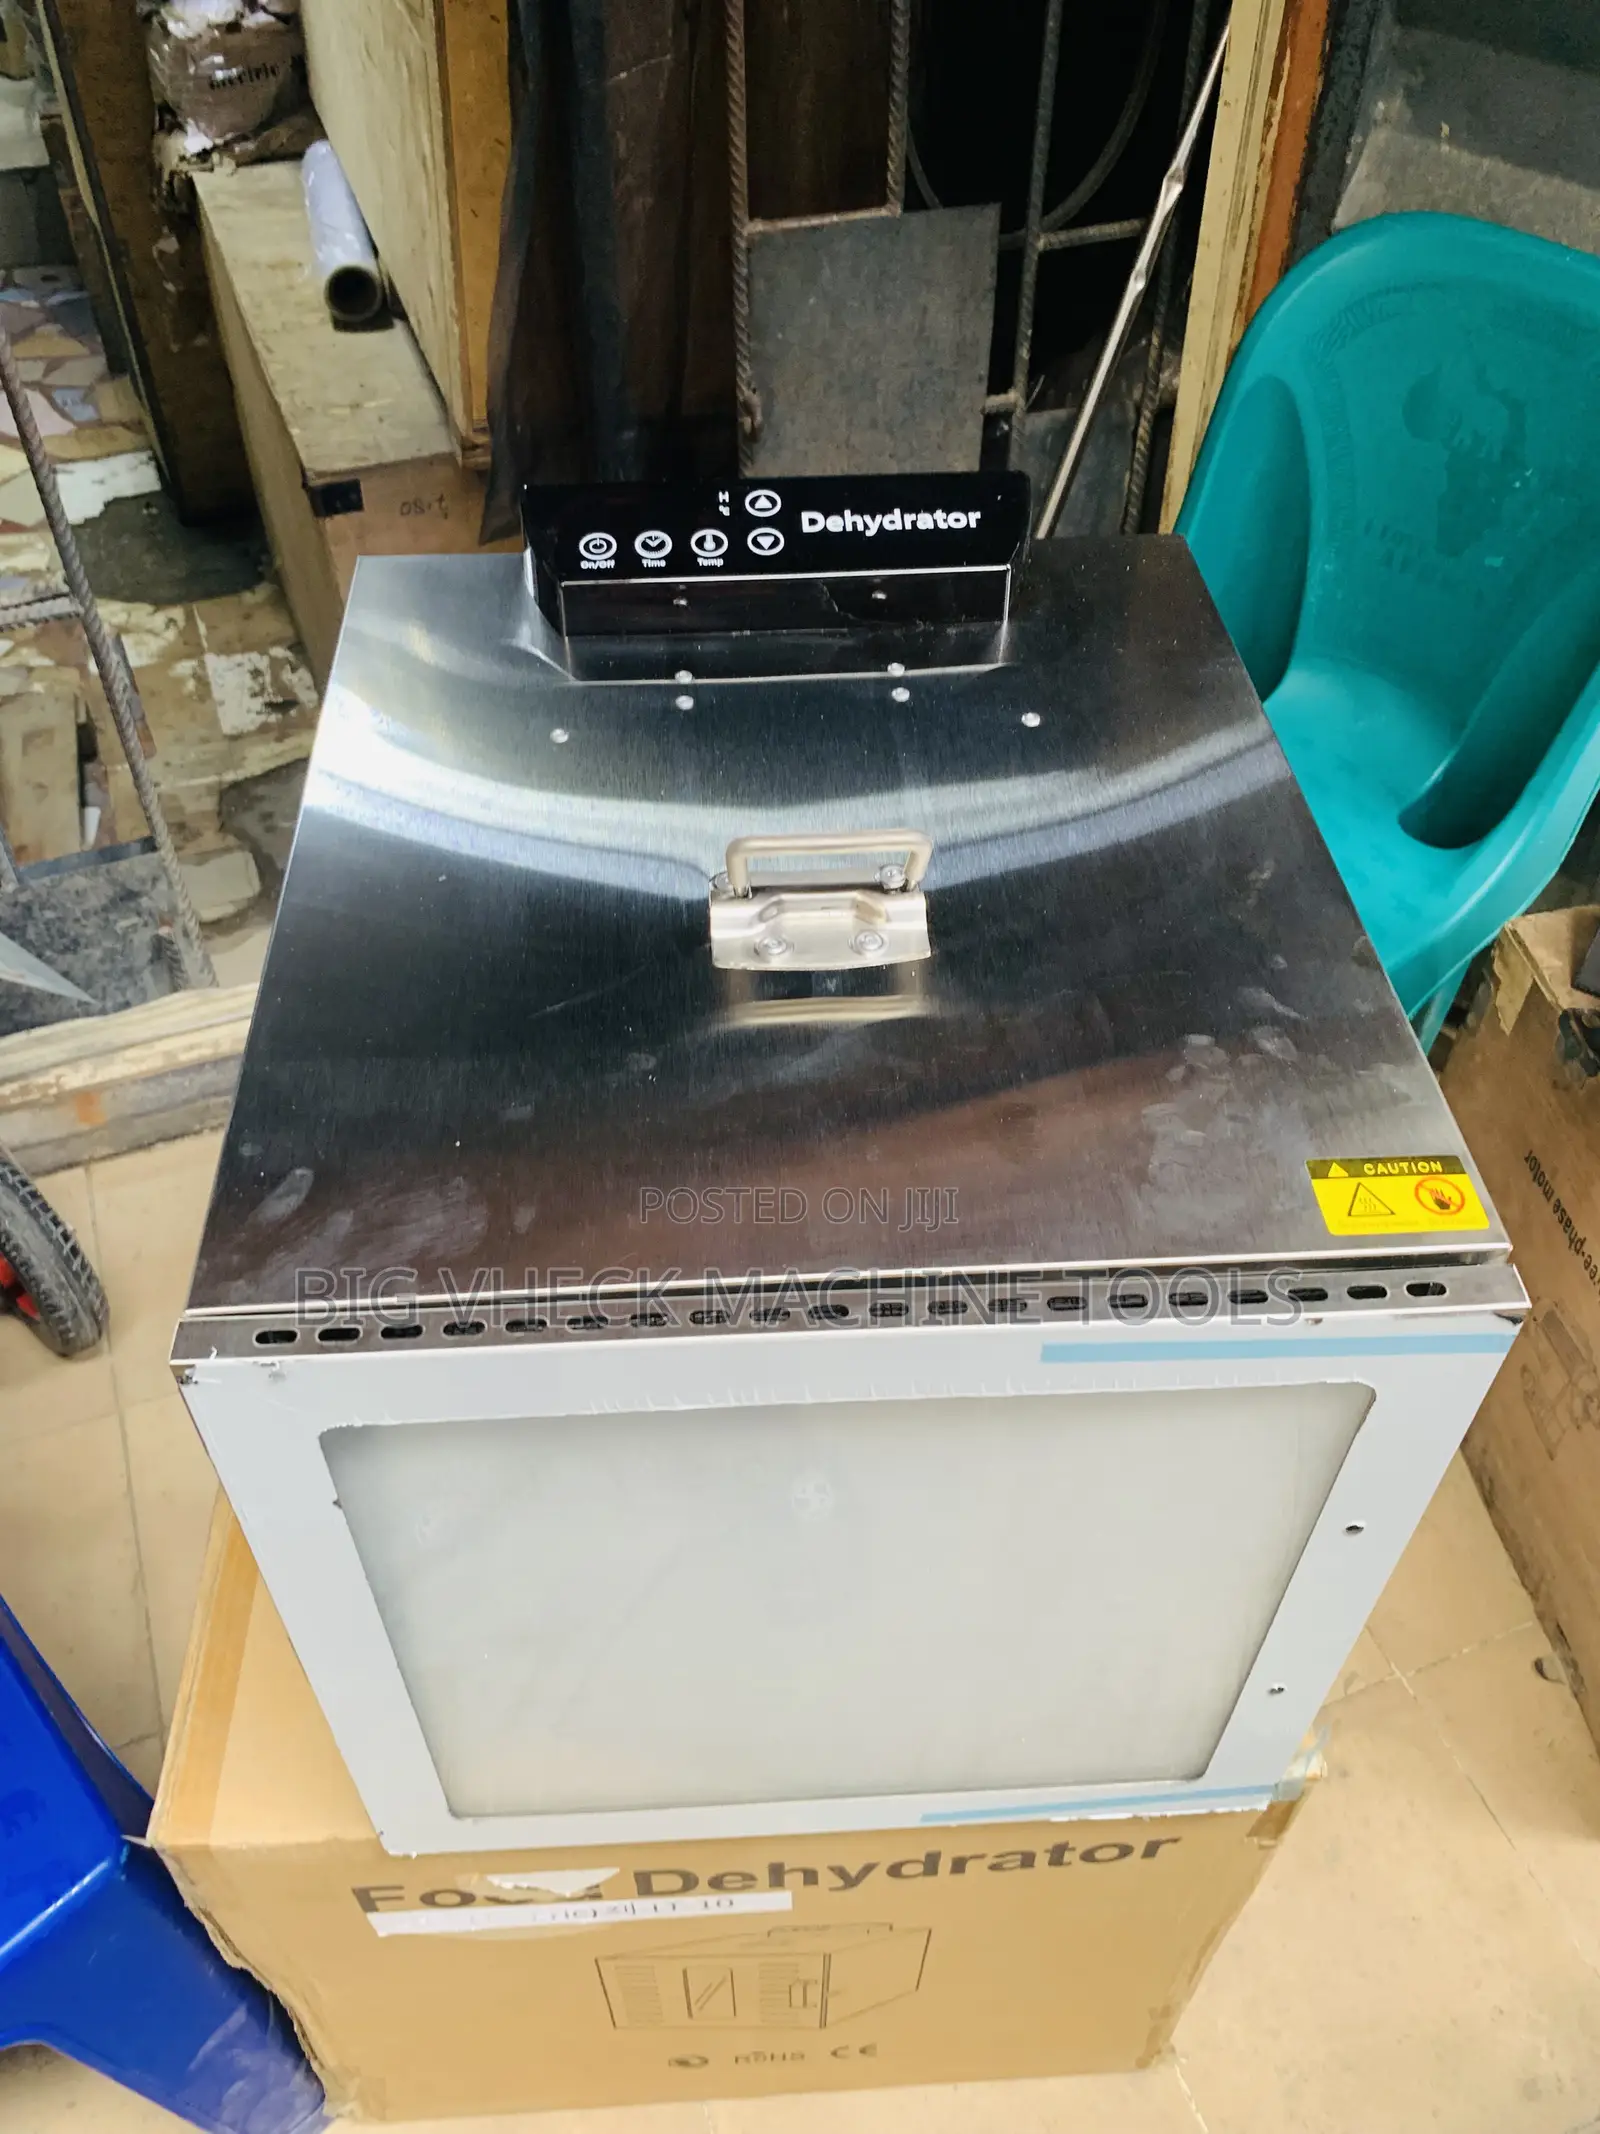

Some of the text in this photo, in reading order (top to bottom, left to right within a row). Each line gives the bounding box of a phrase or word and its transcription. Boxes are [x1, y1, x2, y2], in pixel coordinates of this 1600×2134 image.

[801, 508, 981, 537] Dehydrator
[580, 559, 615, 570] On/Off
[642, 558, 666, 568] Time
[697, 557, 724, 568] Temp
[1363, 1161, 1443, 1176] CAUTION
[1524, 1149, 1555, 1202] motor
[633, 1837, 1182, 1896] Dehydrator
